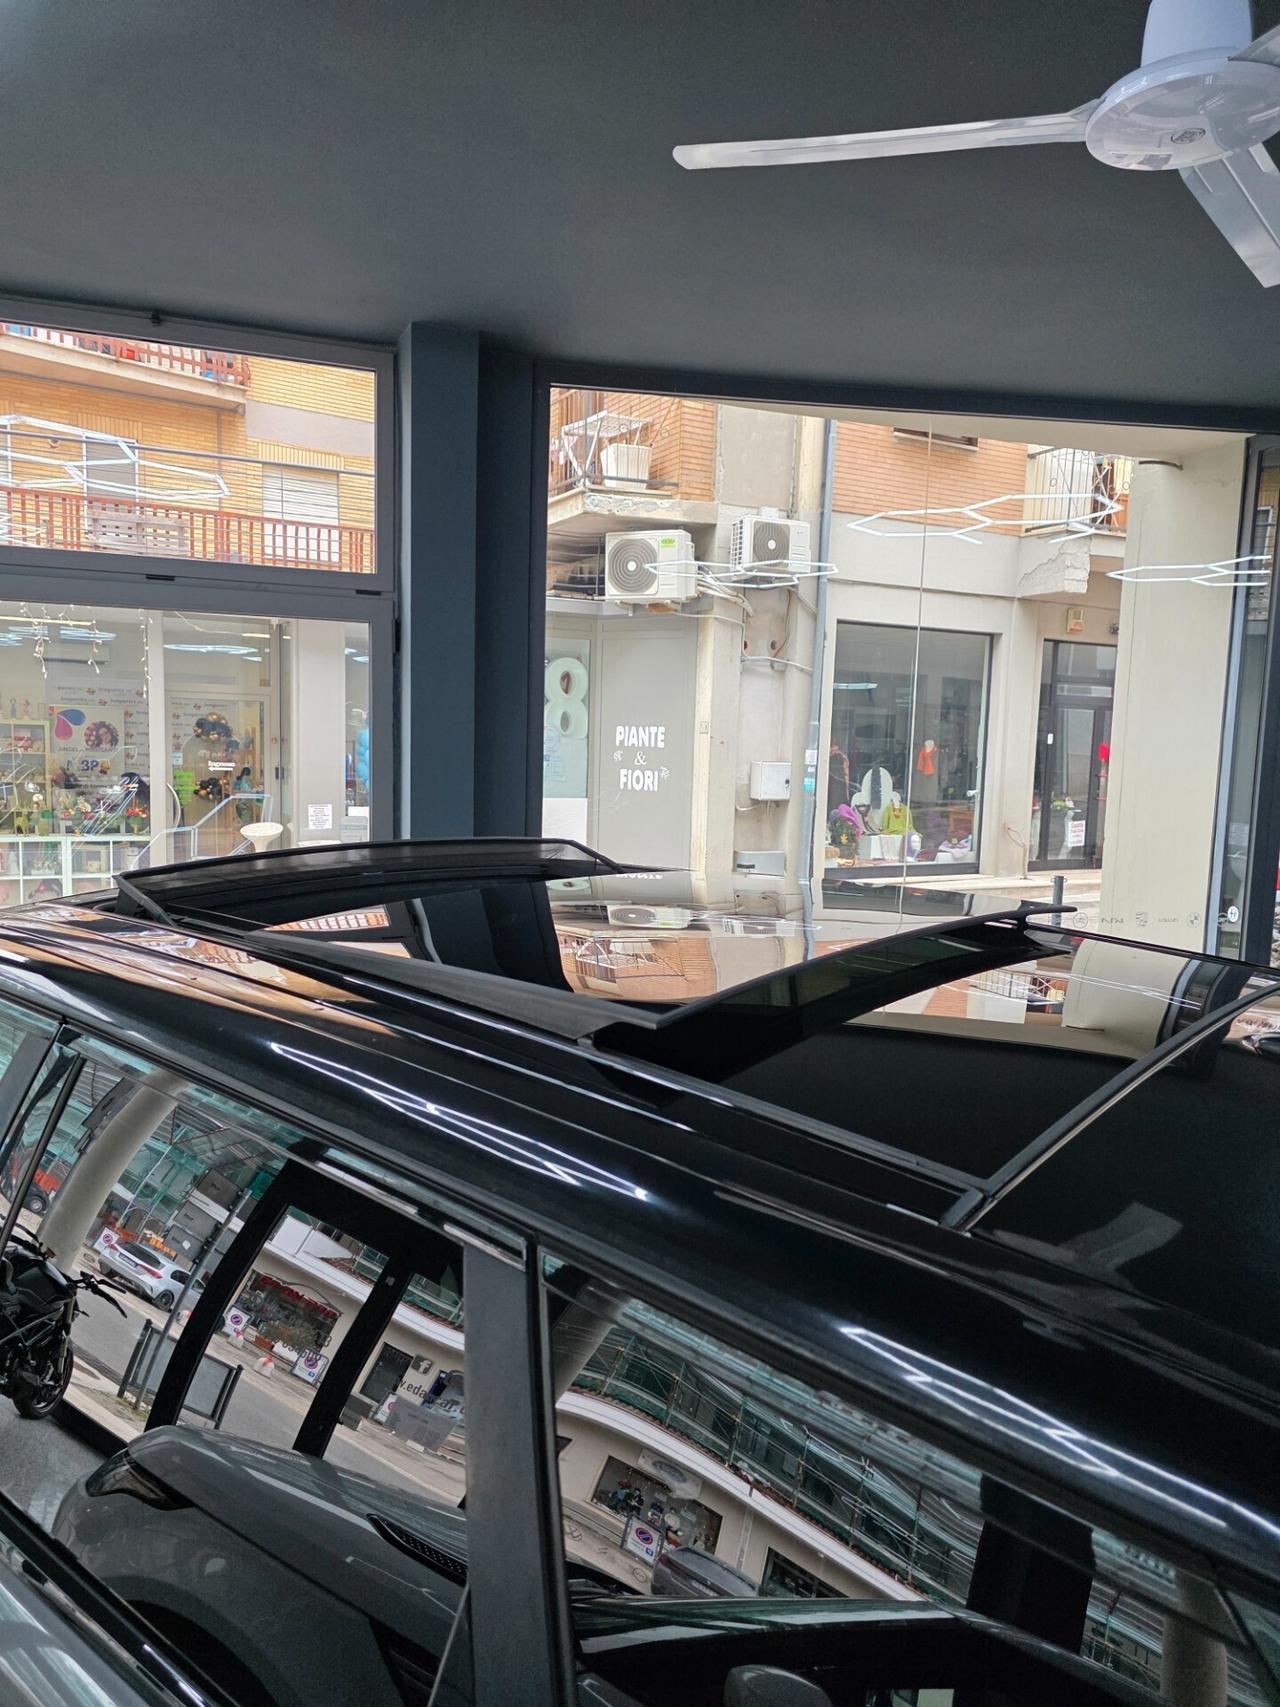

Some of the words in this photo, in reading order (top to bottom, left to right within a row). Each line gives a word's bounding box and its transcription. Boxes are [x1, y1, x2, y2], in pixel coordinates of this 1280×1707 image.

[615, 725, 666, 748] PIANTE
[634, 751, 647, 765] &
[619, 769, 659, 791] FIORI
